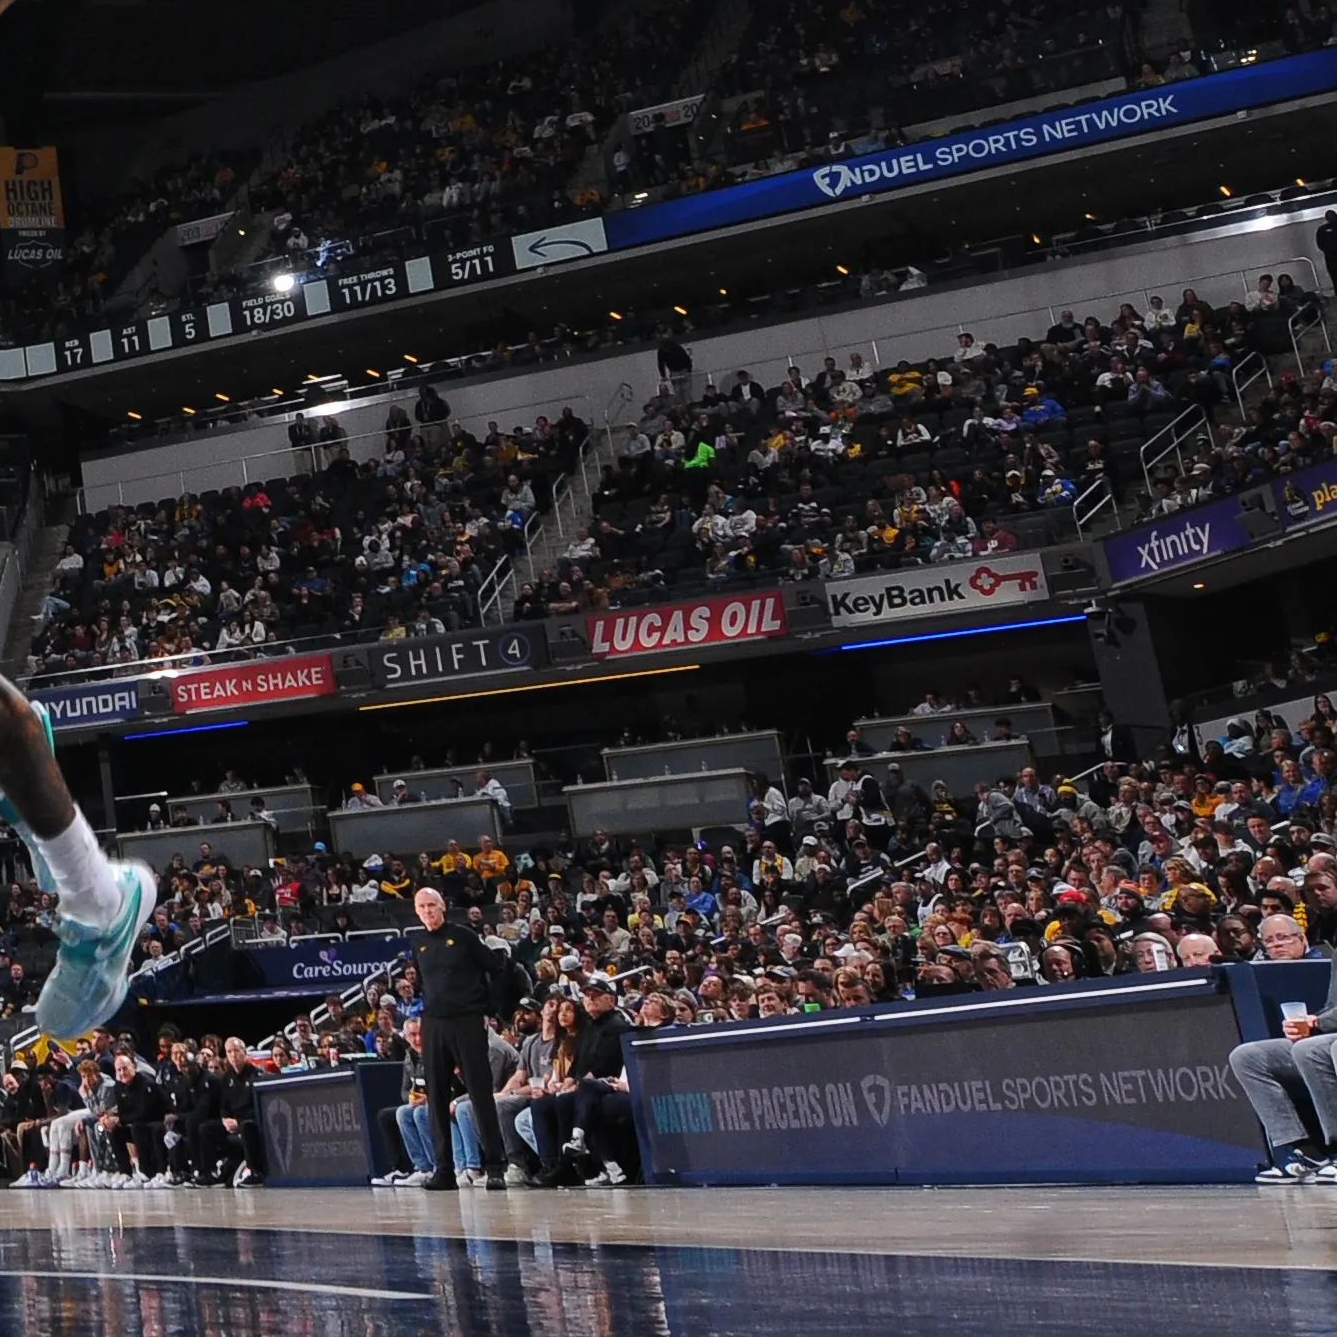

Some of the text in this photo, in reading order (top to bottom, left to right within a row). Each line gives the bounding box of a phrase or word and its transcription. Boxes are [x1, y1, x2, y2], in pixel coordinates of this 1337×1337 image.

[935, 94, 1179, 166] SPORTS NETWORK
[4, 179, 54, 202] HIGH
[7, 202, 55, 217] OCTANE
[8, 216, 58, 228] DRUMLINE
[7, 248, 64, 260] LUCAS OIL
[447, 247, 482, 262] 3-POINT
[338, 267, 394, 287] FREE THROWS
[450, 255, 495, 281] 5/11
[242, 296, 263, 308] FIELD
[341, 277, 397, 304] 11/13
[242, 300, 295, 325] 18/30
[122, 325, 136, 336] AST
[184, 322, 196, 340] 5
[120, 335, 141, 353] 11
[64, 347, 84, 366] 17
[1136, 521, 1210, 570] xfinity
[830, 578, 968, 618] KeyBank
[591, 597, 782, 654] LUCAS OIL
[383, 639, 490, 679] SHIFT
[177, 667, 324, 703] STEAK N SHAKE
[292, 959, 389, 979] CareSource
[650, 1064, 1238, 1134] WATCH THE PACERS ON FANDUEL SPORTS NETWORK
[296, 1102, 361, 1135] FANDUEL
